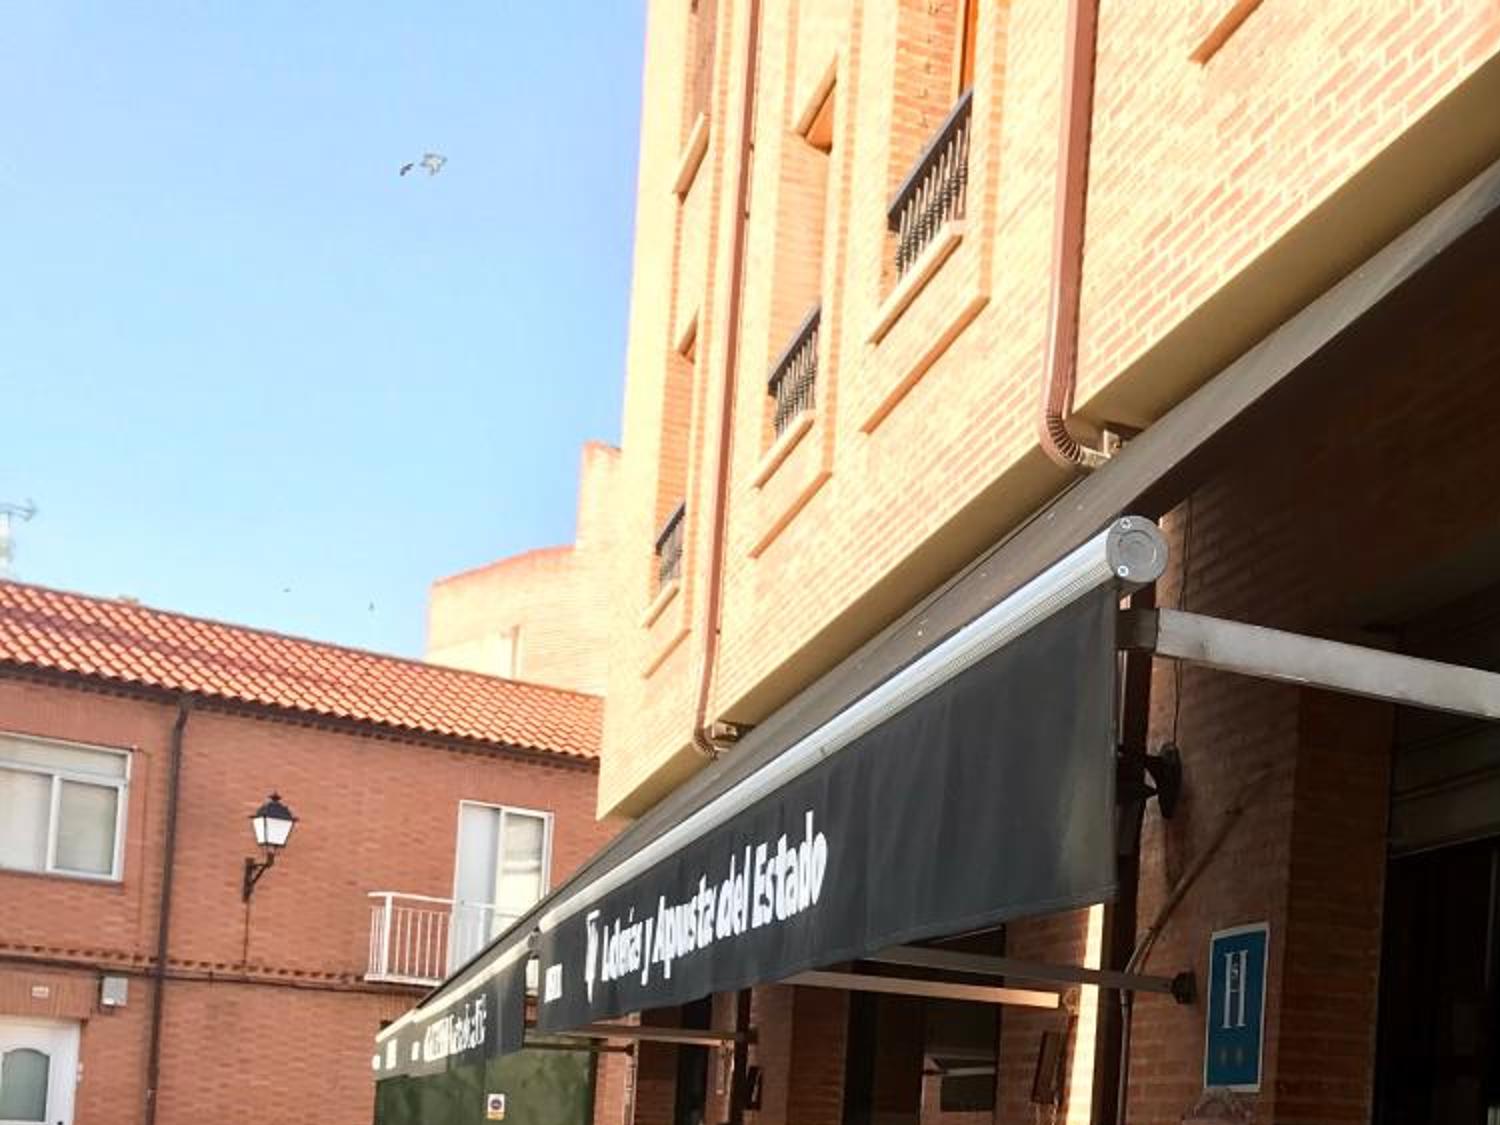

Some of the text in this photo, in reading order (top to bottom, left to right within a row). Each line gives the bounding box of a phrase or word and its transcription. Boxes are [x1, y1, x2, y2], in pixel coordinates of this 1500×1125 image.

[641, 917, 653, 986] y
[716, 846, 751, 940] del
[752, 811, 828, 929] Estado
[1221, 950, 1248, 1029] H
